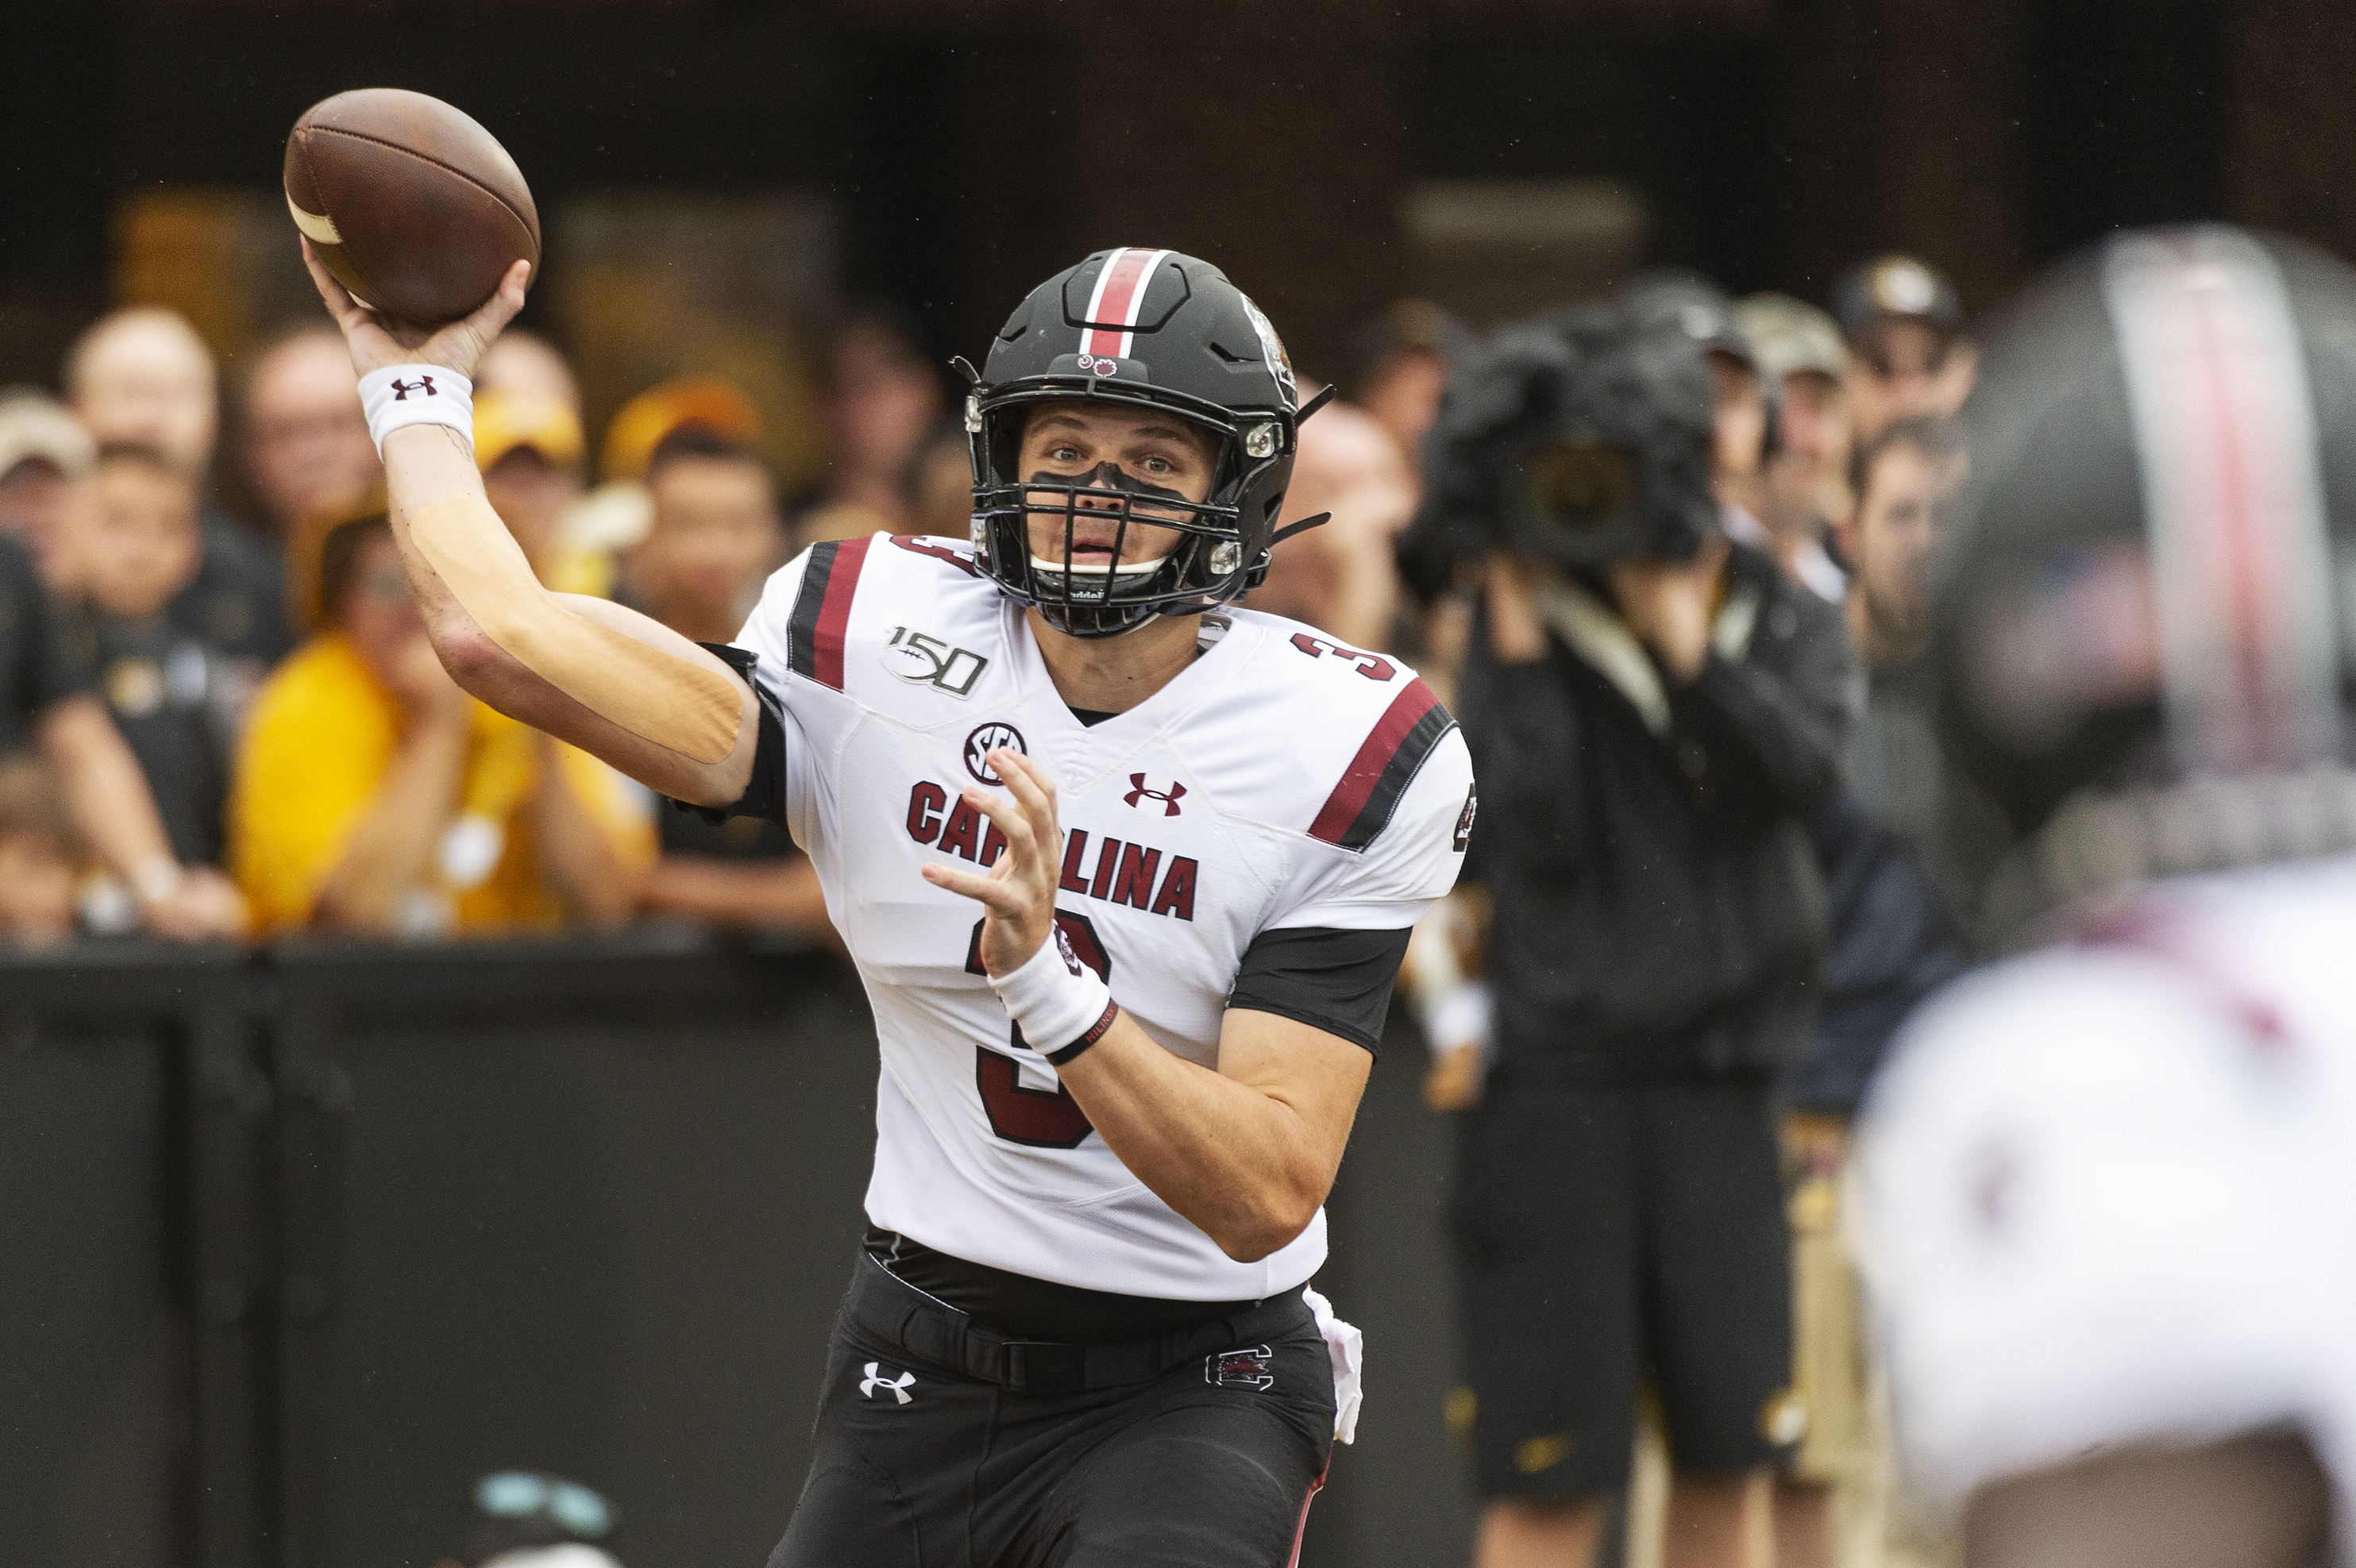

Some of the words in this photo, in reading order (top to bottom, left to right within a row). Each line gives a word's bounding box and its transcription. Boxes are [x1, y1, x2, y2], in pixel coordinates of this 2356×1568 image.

[889, 626, 988, 696] 150
[1290, 633, 1397, 682] 3
[906, 780, 1198, 921] CALINA
[965, 907, 1112, 1150] 3
